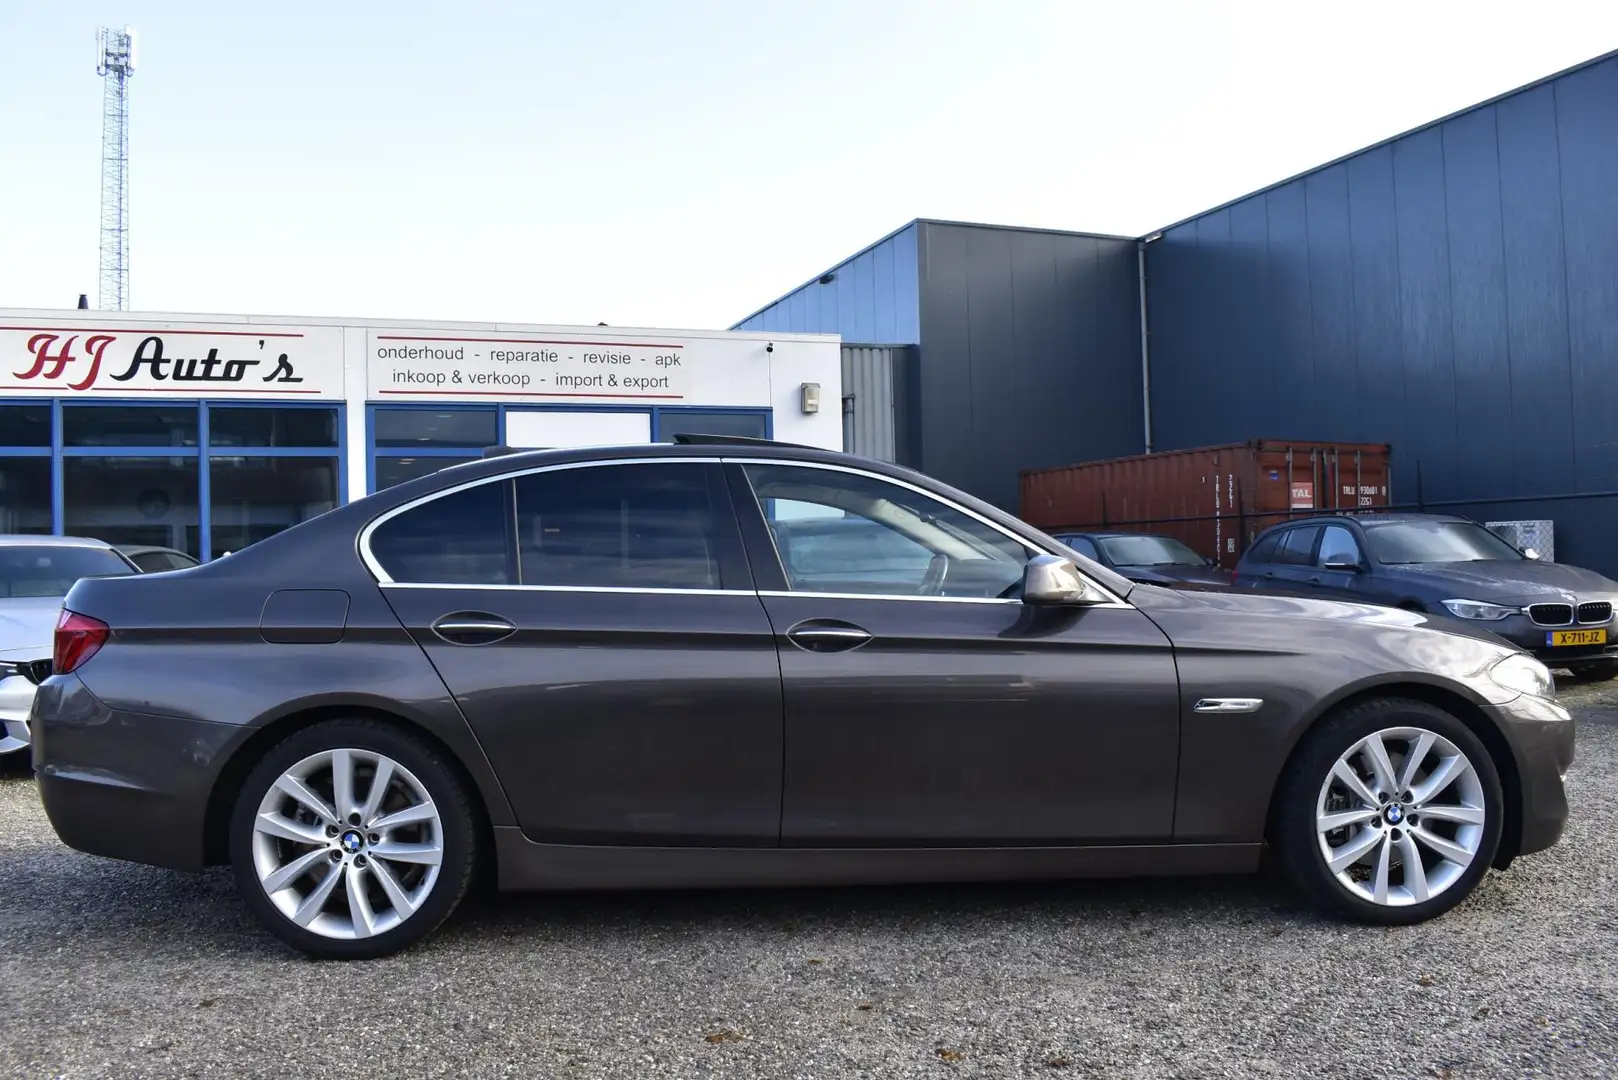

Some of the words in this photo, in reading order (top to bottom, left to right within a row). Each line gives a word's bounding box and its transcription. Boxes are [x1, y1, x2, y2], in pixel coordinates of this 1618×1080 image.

[12, 333, 117, 391] HJ
[109, 336, 304, 383] Auto's
[377, 346, 464, 360] onderhoud
[490, 349, 558, 364] reparatie
[583, 351, 631, 365] revisie
[655, 353, 681, 369] apk
[392, 369, 446, 386] inkoop
[451, 370, 463, 384] &
[468, 371, 531, 388] verkoop
[555, 372, 603, 389] import
[608, 374, 619, 387] &
[623, 375, 670, 391] export
[1291, 488, 1313, 498] TAL
[1560, 631, 1600, 644] X-711-JZ
